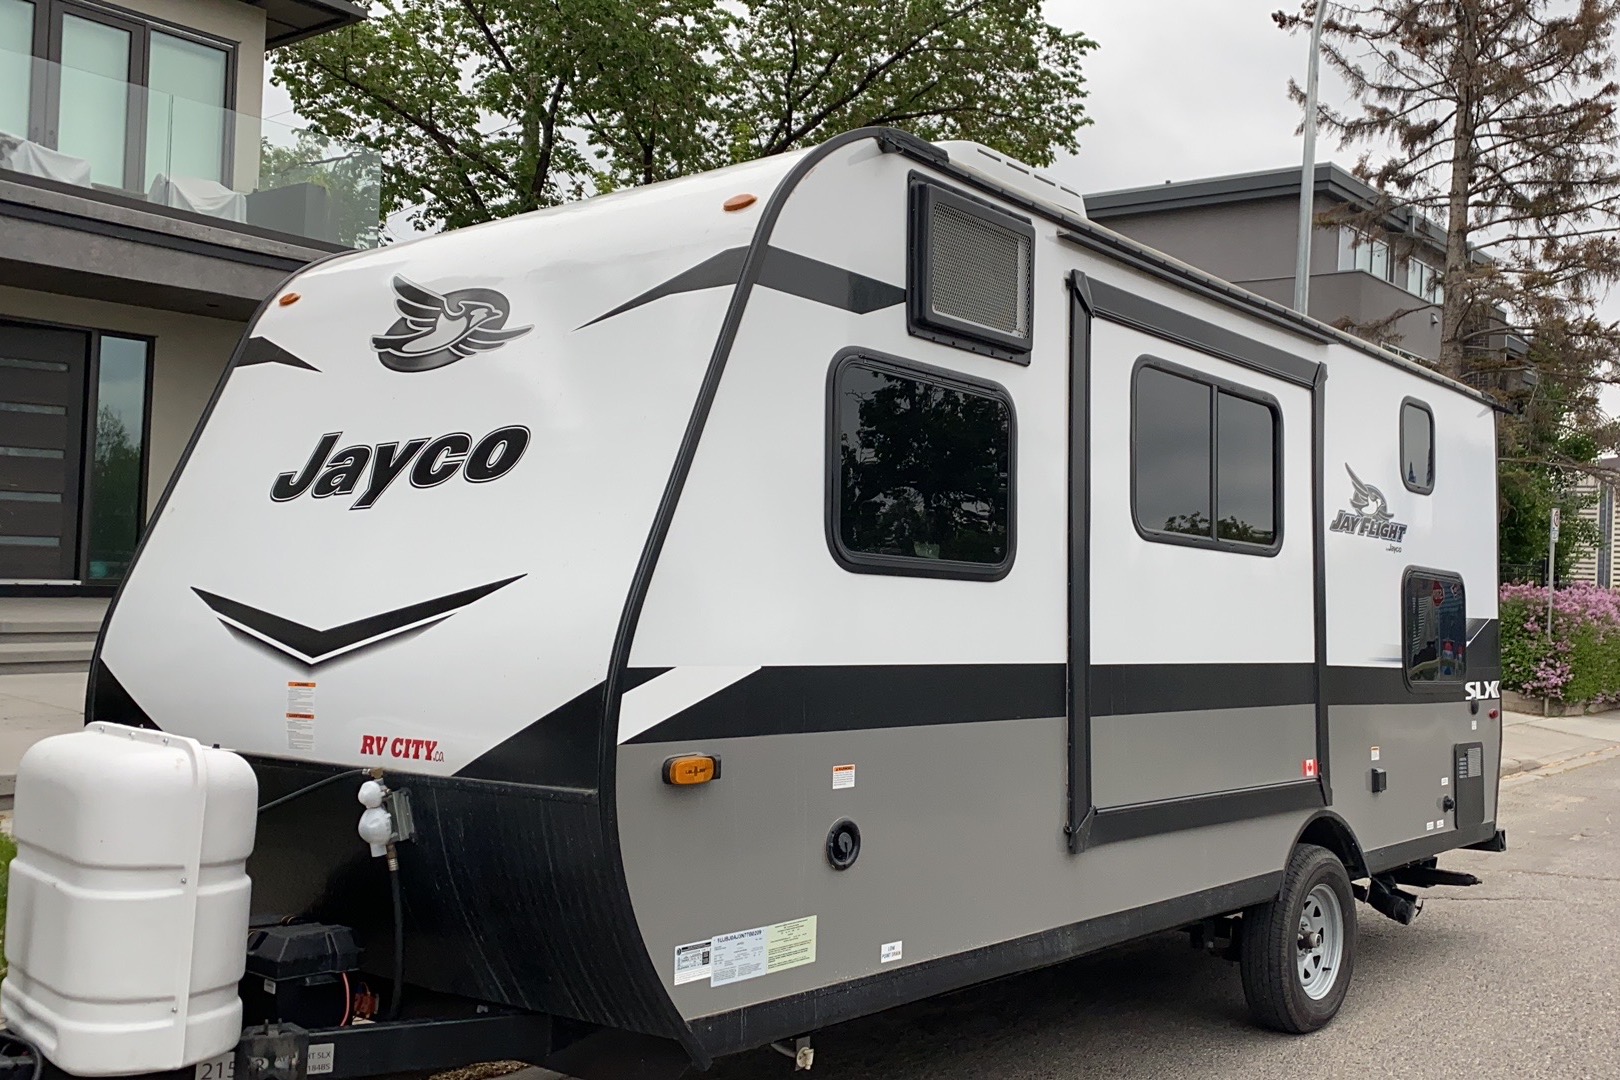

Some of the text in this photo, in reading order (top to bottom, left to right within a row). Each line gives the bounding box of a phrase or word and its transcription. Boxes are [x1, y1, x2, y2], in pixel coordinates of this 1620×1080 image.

[270, 424, 531, 511] Jayco
[1329, 509, 1407, 542] JAY FLIGHT
[1465, 680, 1500, 700] SLX
[360, 735, 388, 756] RV
[317, 1051, 331, 1059] SLX
